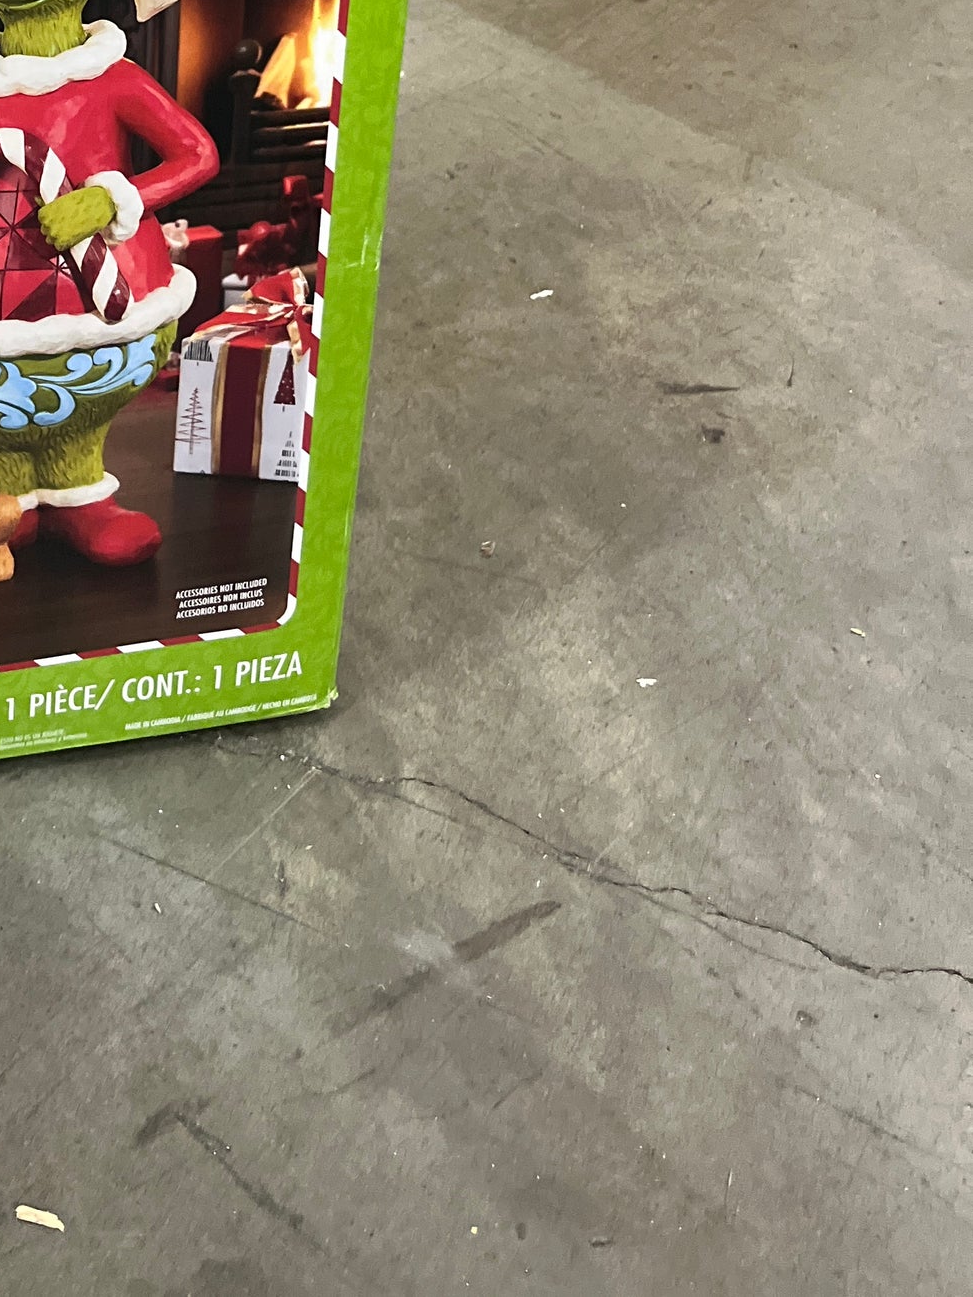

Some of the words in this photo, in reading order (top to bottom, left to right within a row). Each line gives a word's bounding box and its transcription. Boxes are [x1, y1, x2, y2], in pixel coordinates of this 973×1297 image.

[175, 585, 218, 599] ACCESSORIES
[219, 583, 234, 593] NOT
[234, 578, 268, 591] INCLUDED
[179, 595, 222, 609] ACCESSOIRES
[222, 593, 239, 602] NON
[240, 588, 263, 600] INCLUS
[176, 606, 217, 620] ACCESORIOS
[217, 604, 229, 613] NO
[229, 598, 265, 611] INCLUIDOS
[5, 697, 15, 721] 1
[29, 679, 116, 718] PIÈCE/
[121, 670, 202, 703] CONT.:
[213, 665, 223, 690] 1
[235, 651, 303, 687] PIEZA
